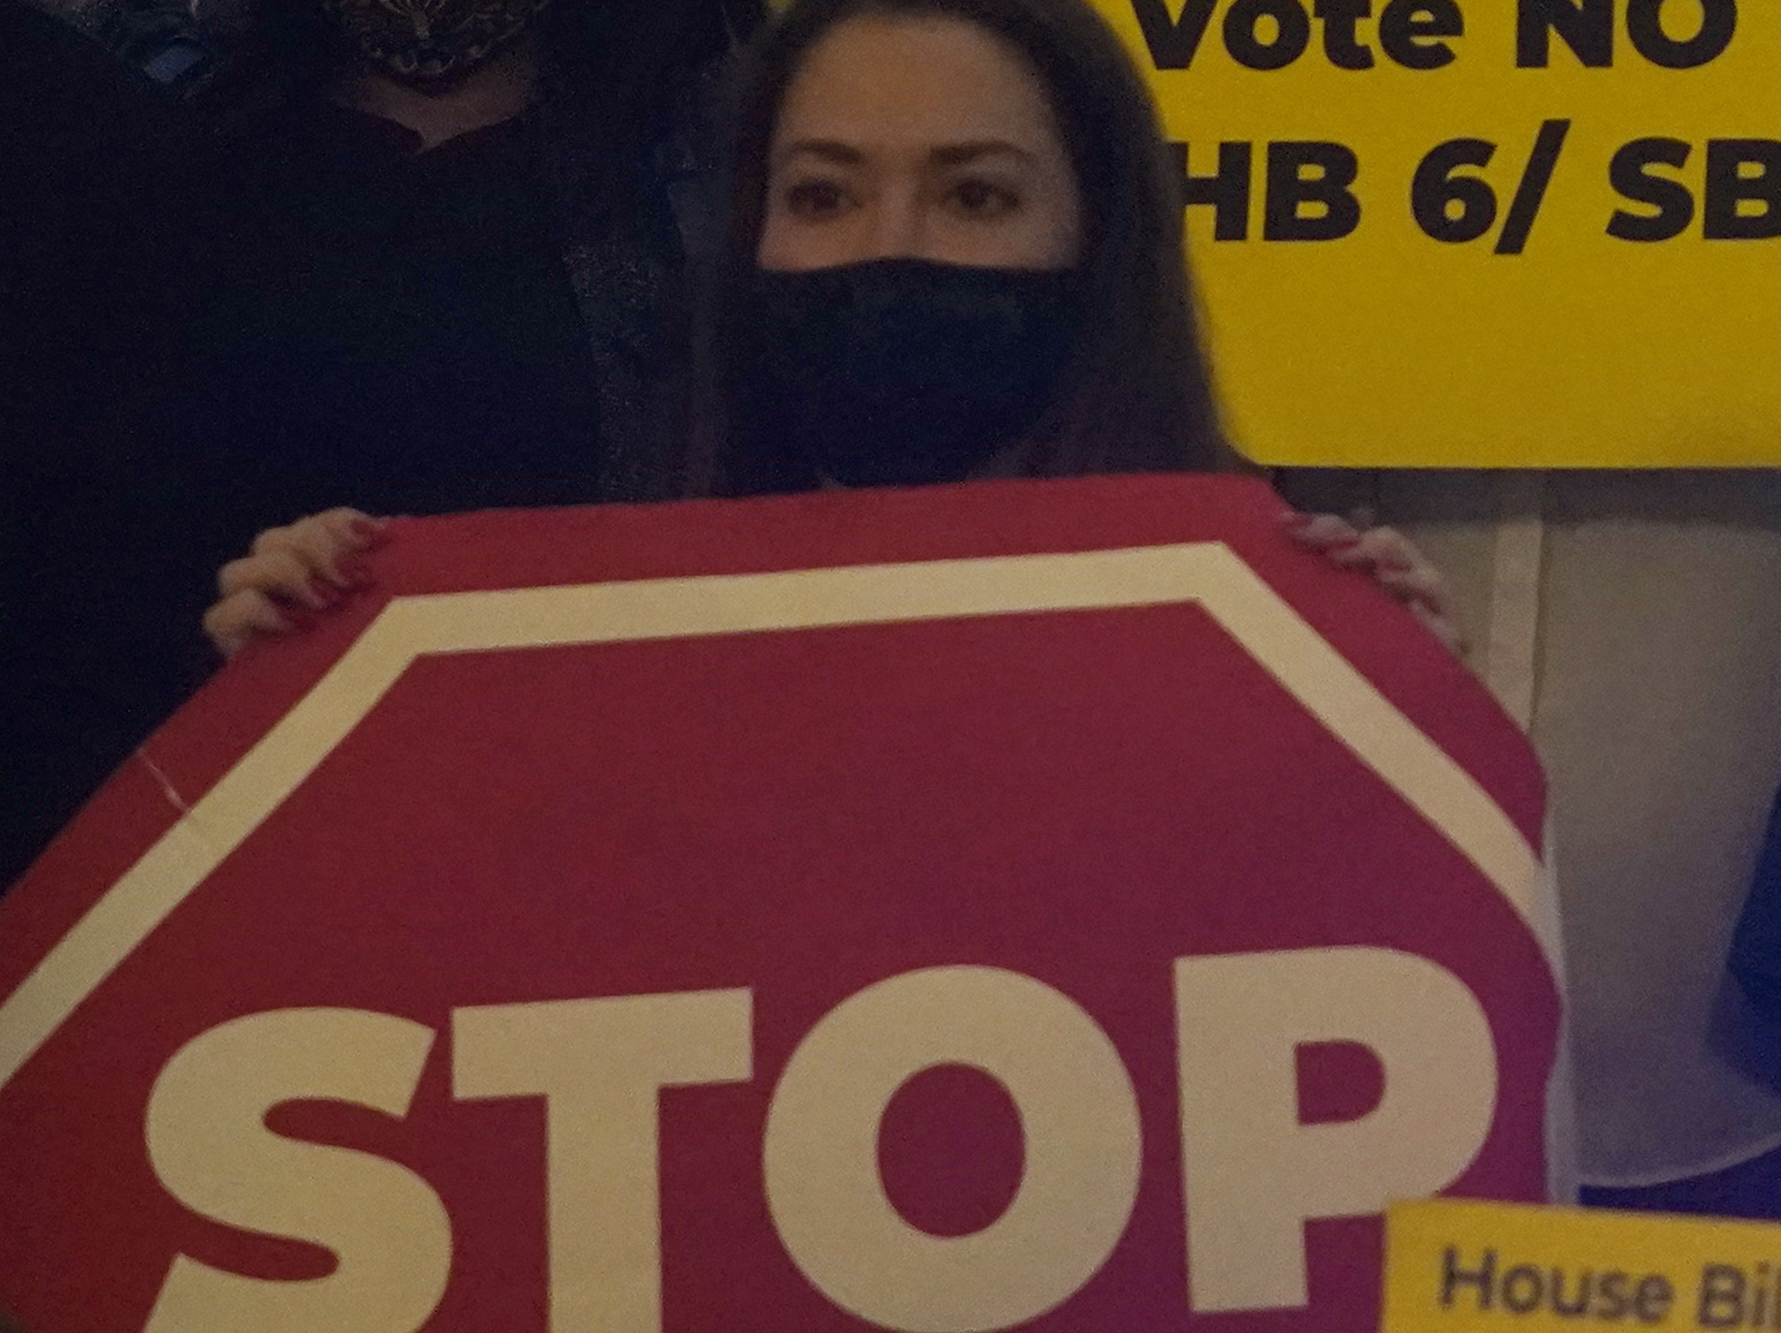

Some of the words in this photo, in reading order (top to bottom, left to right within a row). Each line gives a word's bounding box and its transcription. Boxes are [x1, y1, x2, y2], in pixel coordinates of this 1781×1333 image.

[1168, 139, 1361, 244] HB
[1410, 119, 1571, 257] 6/
[140, 945, 1498, 1333] STOP
[1438, 1245, 1673, 1322] House
